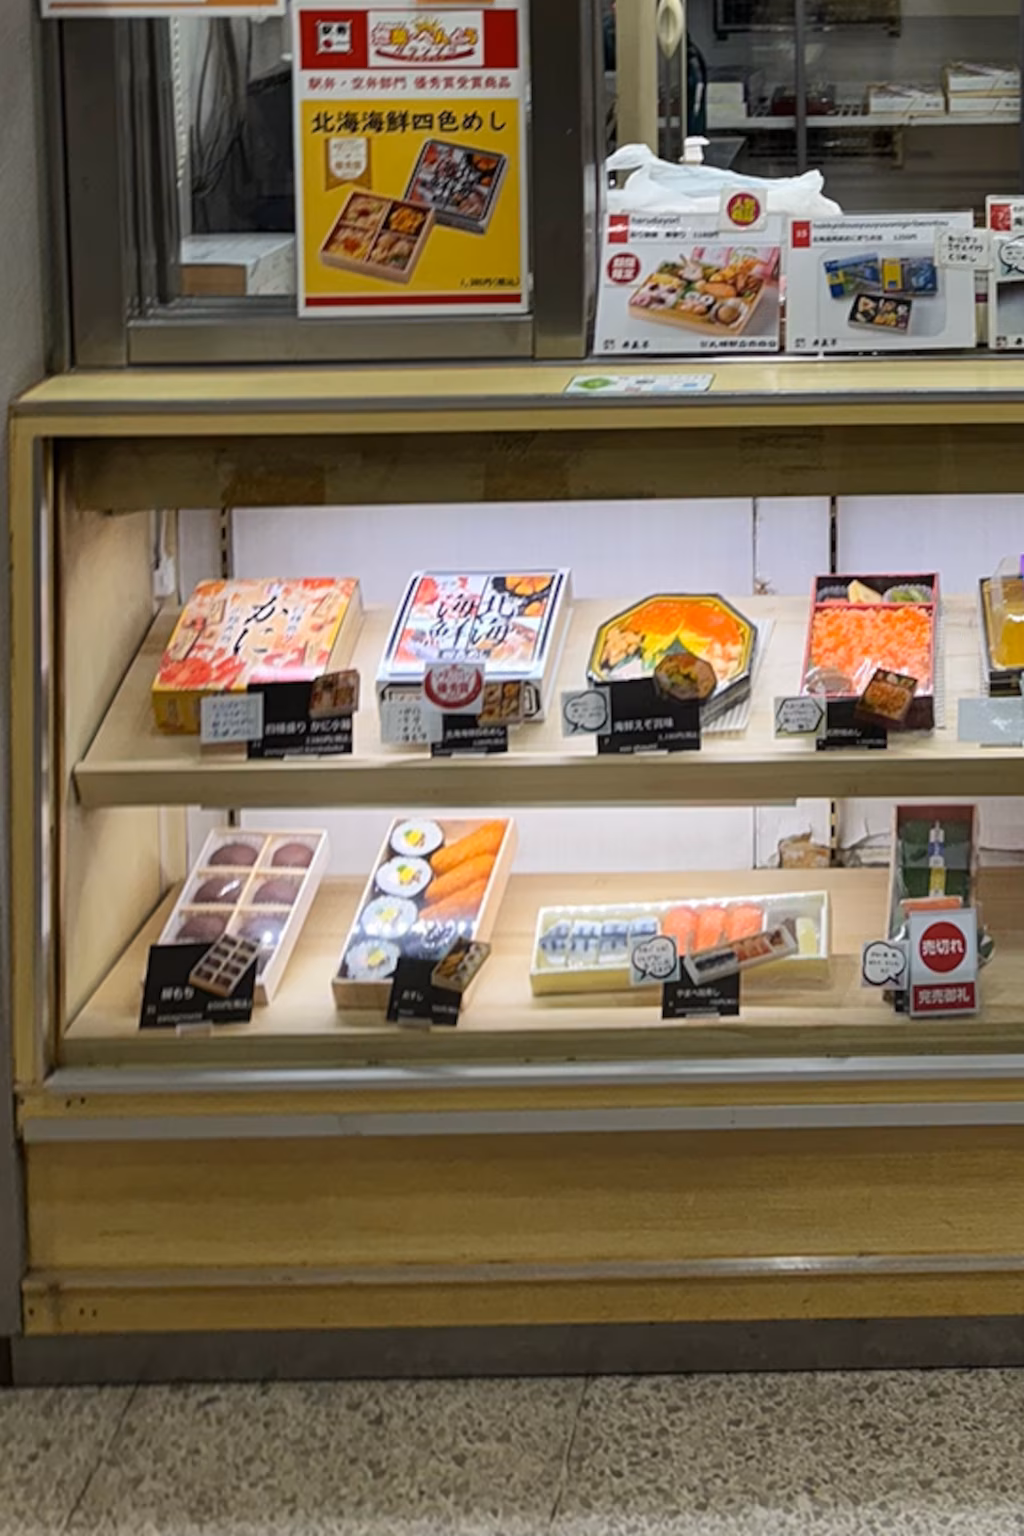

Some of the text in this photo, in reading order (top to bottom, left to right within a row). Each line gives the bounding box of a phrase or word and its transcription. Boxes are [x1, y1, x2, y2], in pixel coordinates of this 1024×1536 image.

[311, 109, 507, 134] 北海海鮮四色めし
[921, 939, 964, 955] 売切れ
[918, 990, 970, 1005] 完売御礼
